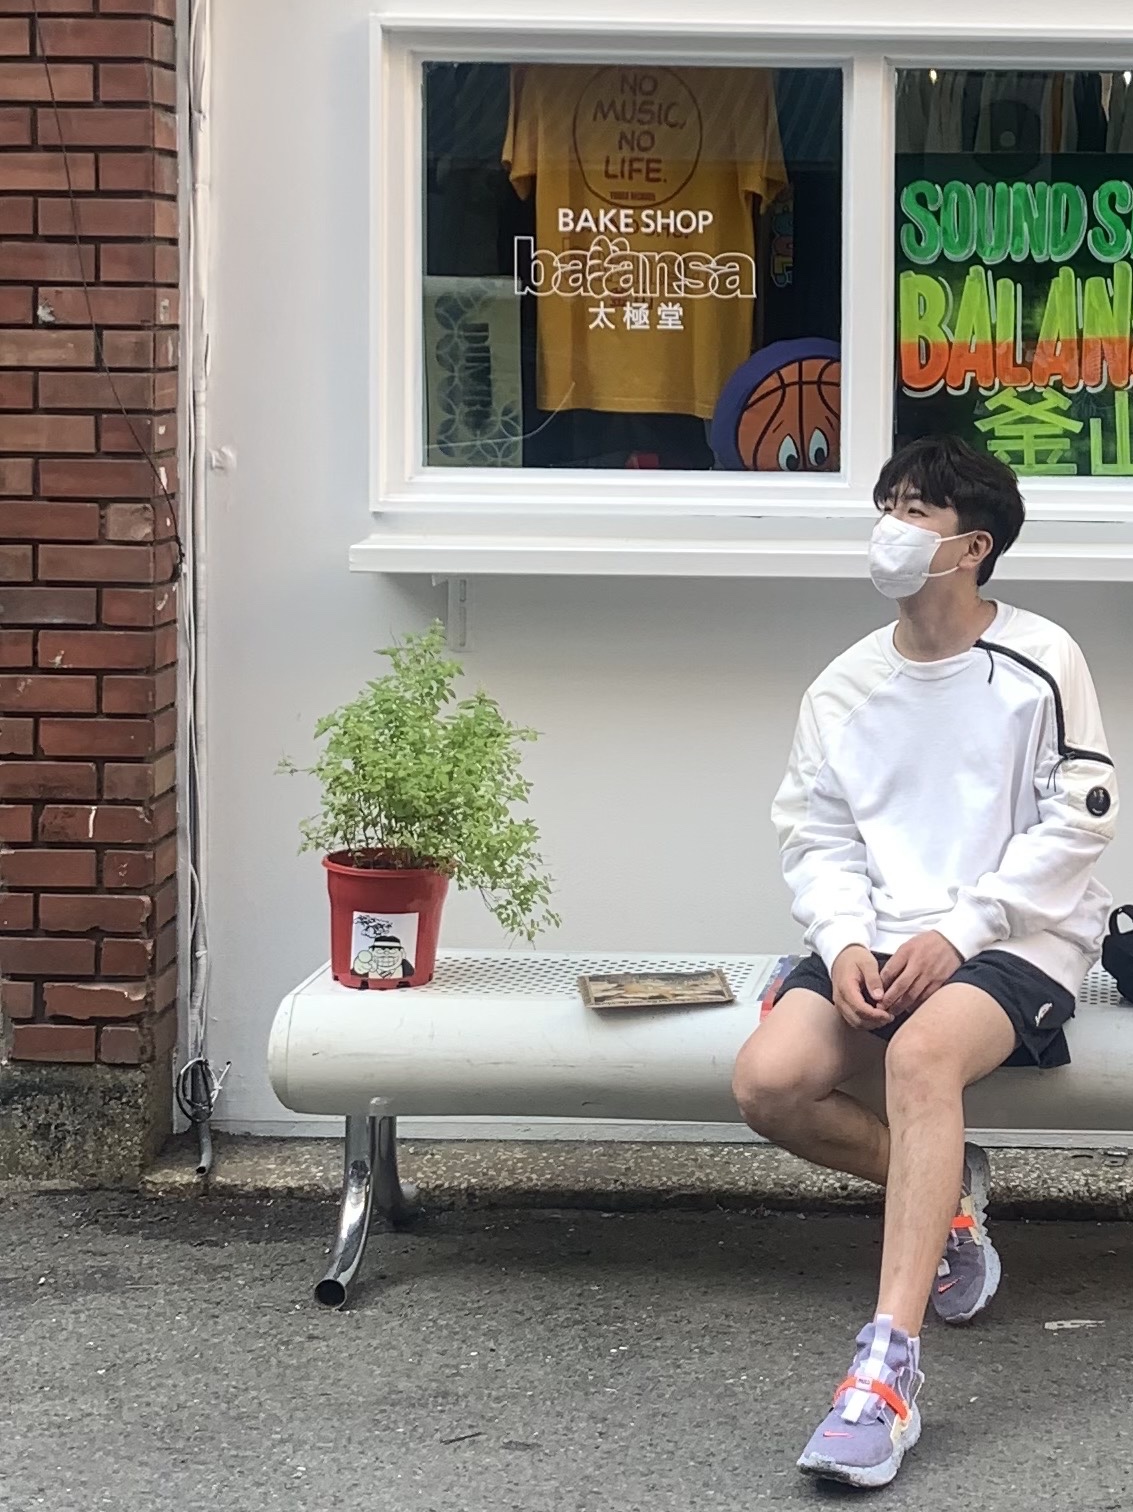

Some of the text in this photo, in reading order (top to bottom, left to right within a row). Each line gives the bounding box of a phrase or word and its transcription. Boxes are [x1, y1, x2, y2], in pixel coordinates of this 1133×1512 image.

[619, 73, 659, 97] NO
[593, 99, 688, 130] MUSIC,
[618, 130, 656, 153] NO
[604, 156, 668, 184] LIFE.
[558, 208, 634, 234] BAKE
[641, 209, 714, 234] SHOP
[901, 179, 1088, 265] SOUND
[588, 301, 685, 331] 太極堂
